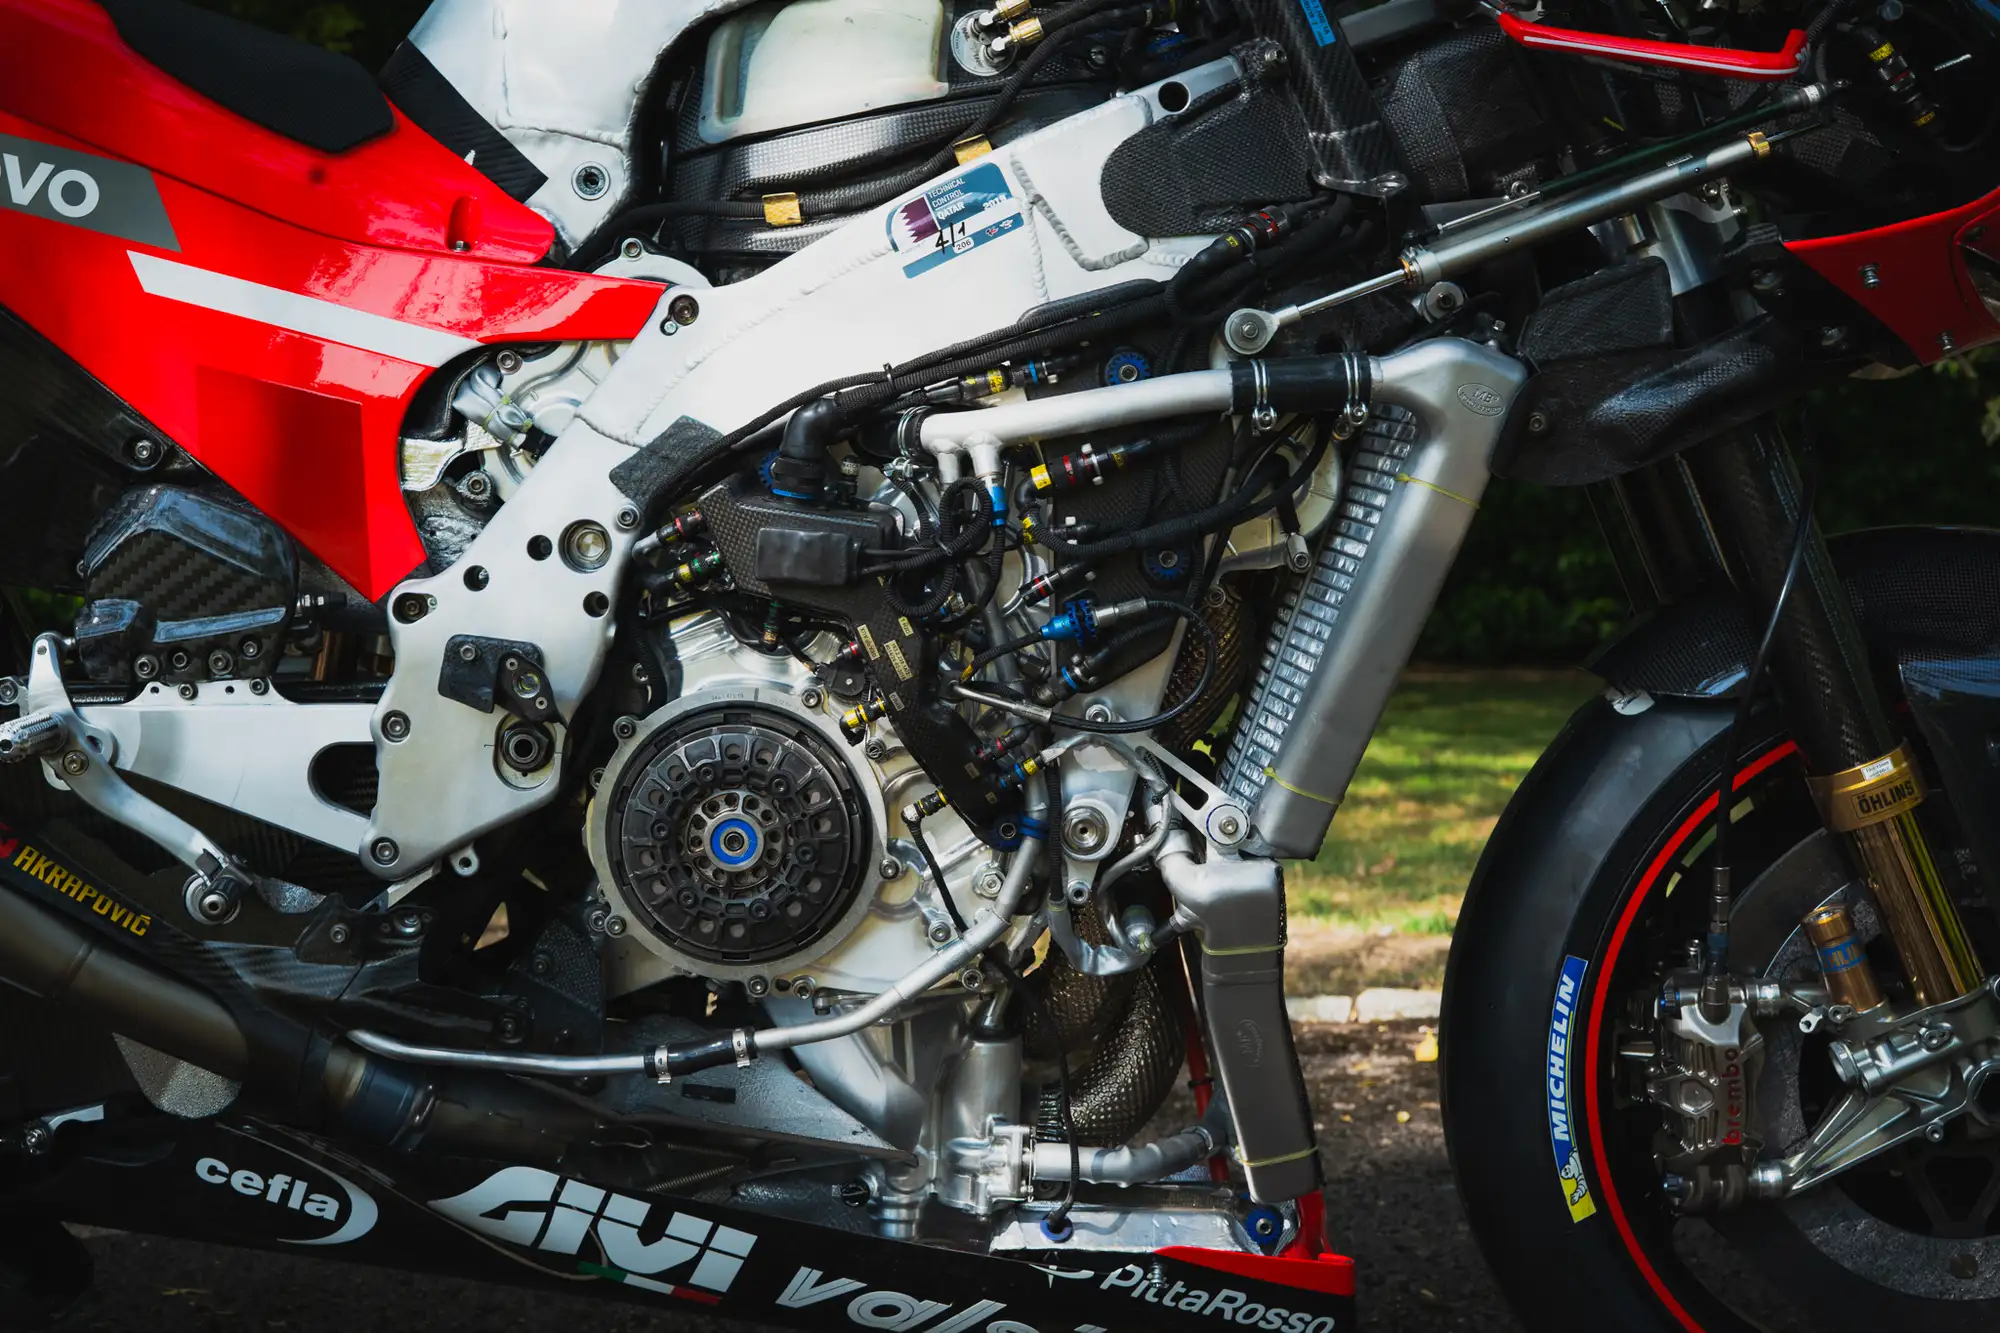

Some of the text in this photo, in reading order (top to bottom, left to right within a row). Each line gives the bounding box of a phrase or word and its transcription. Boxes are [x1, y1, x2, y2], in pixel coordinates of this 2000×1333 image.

[928, 178, 966, 199] TECHNICAL
[932, 189, 965, 208] CONTROL
[937, 201, 965, 220] QATAR
[955, 240, 972, 251] 206
[1857, 779, 1915, 814] ÖHLINS
[13, 845, 151, 937] AKRAPOVIĆ
[1550, 973, 1575, 1142] MICHELIN
[1721, 1048, 1741, 1145] brembo
[195, 1157, 340, 1221] cefla
[428, 1166, 758, 1293] GIVI
